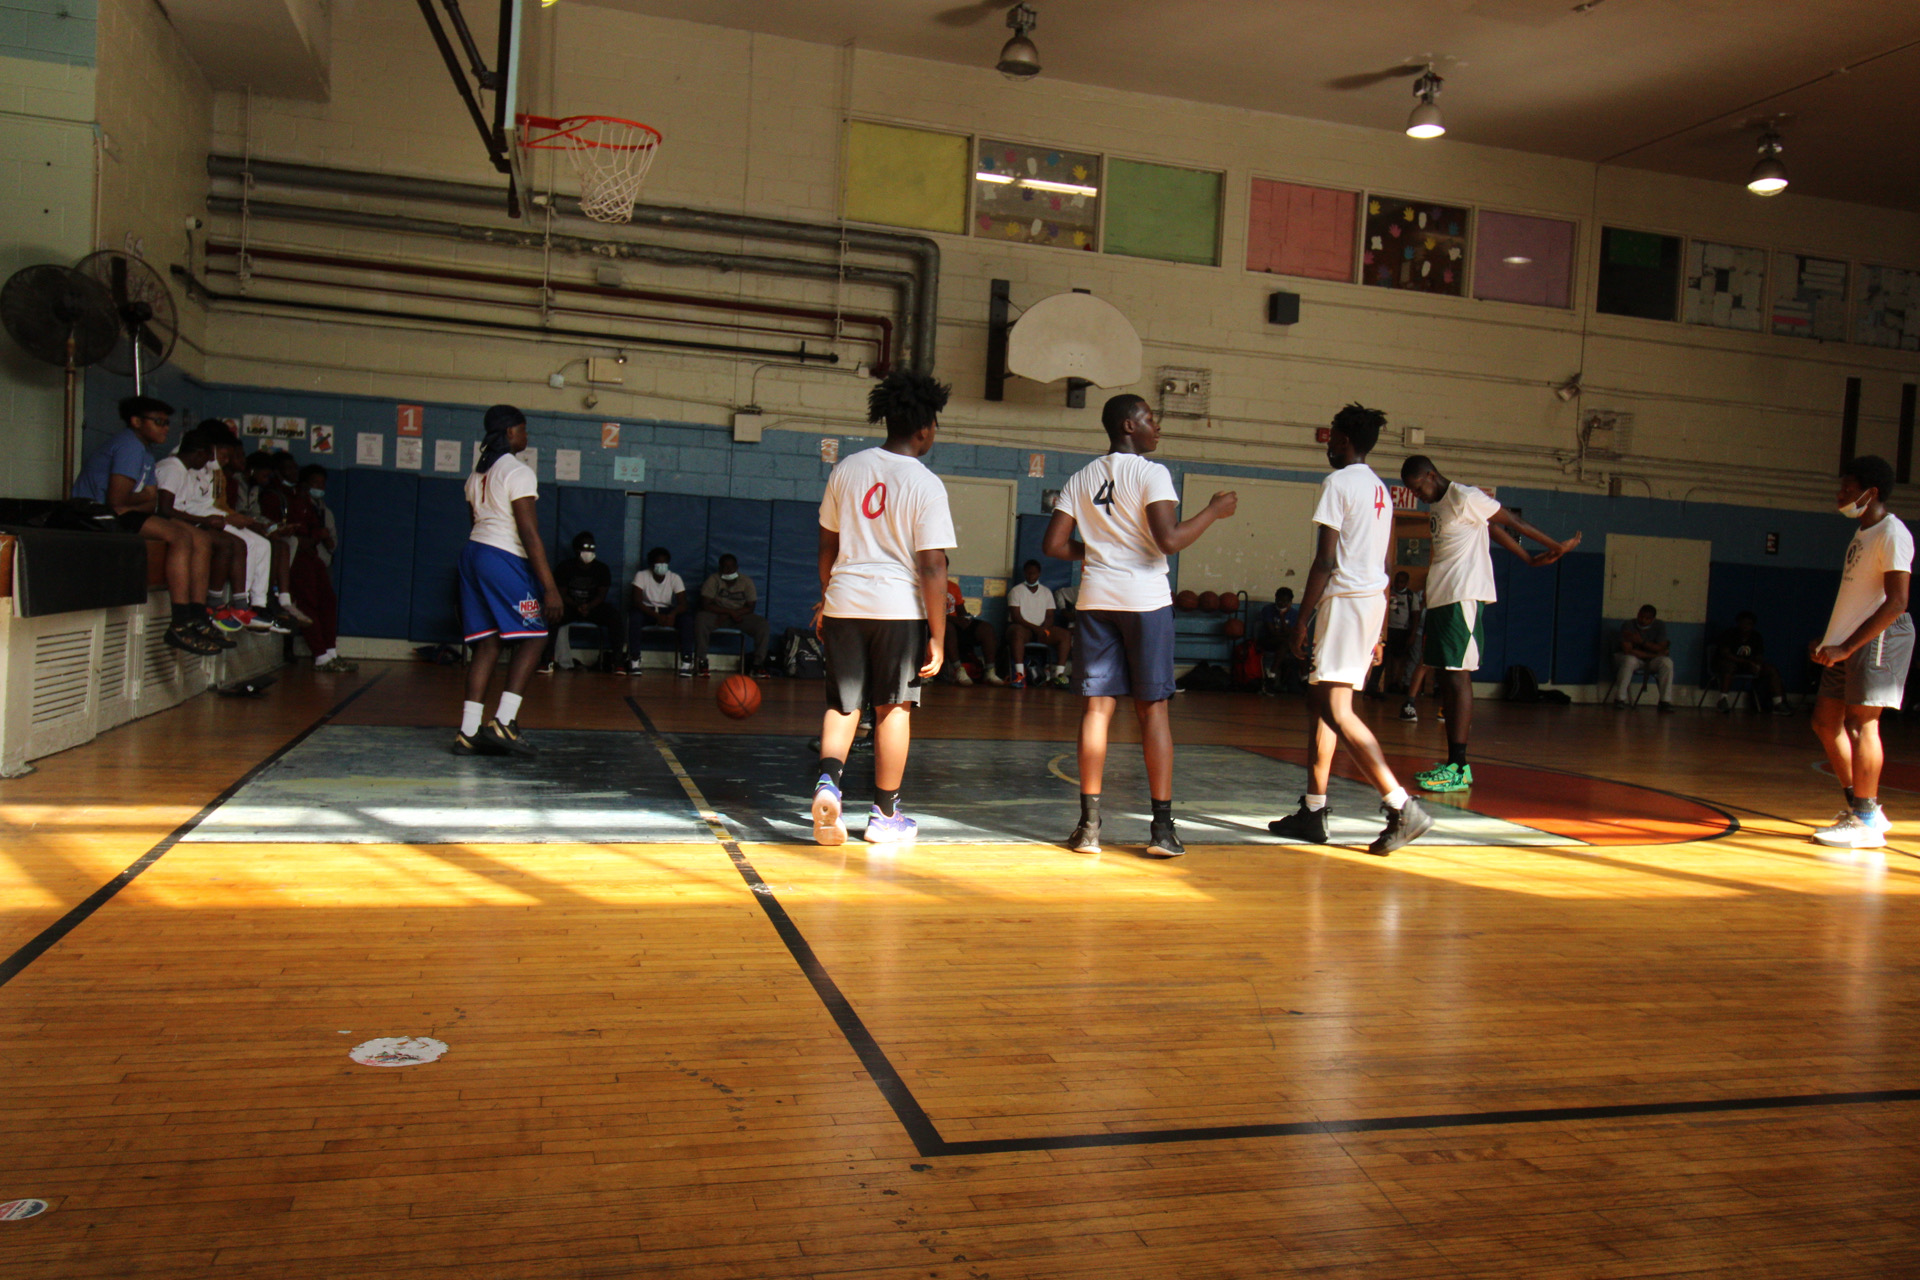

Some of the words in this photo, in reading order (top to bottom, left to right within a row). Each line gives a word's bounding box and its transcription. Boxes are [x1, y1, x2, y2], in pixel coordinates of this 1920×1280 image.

[402, 408, 418, 431] 1
[603, 425, 618, 446] 2
[821, 440, 838, 459] 3
[1030, 455, 1042, 473] 4
[480, 475, 488, 504] 1
[1092, 479, 1115, 516] 4
[1391, 486, 1416, 509] EXIT
[1374, 485, 1385, 519] 4
[520, 600, 540, 612] NBA
